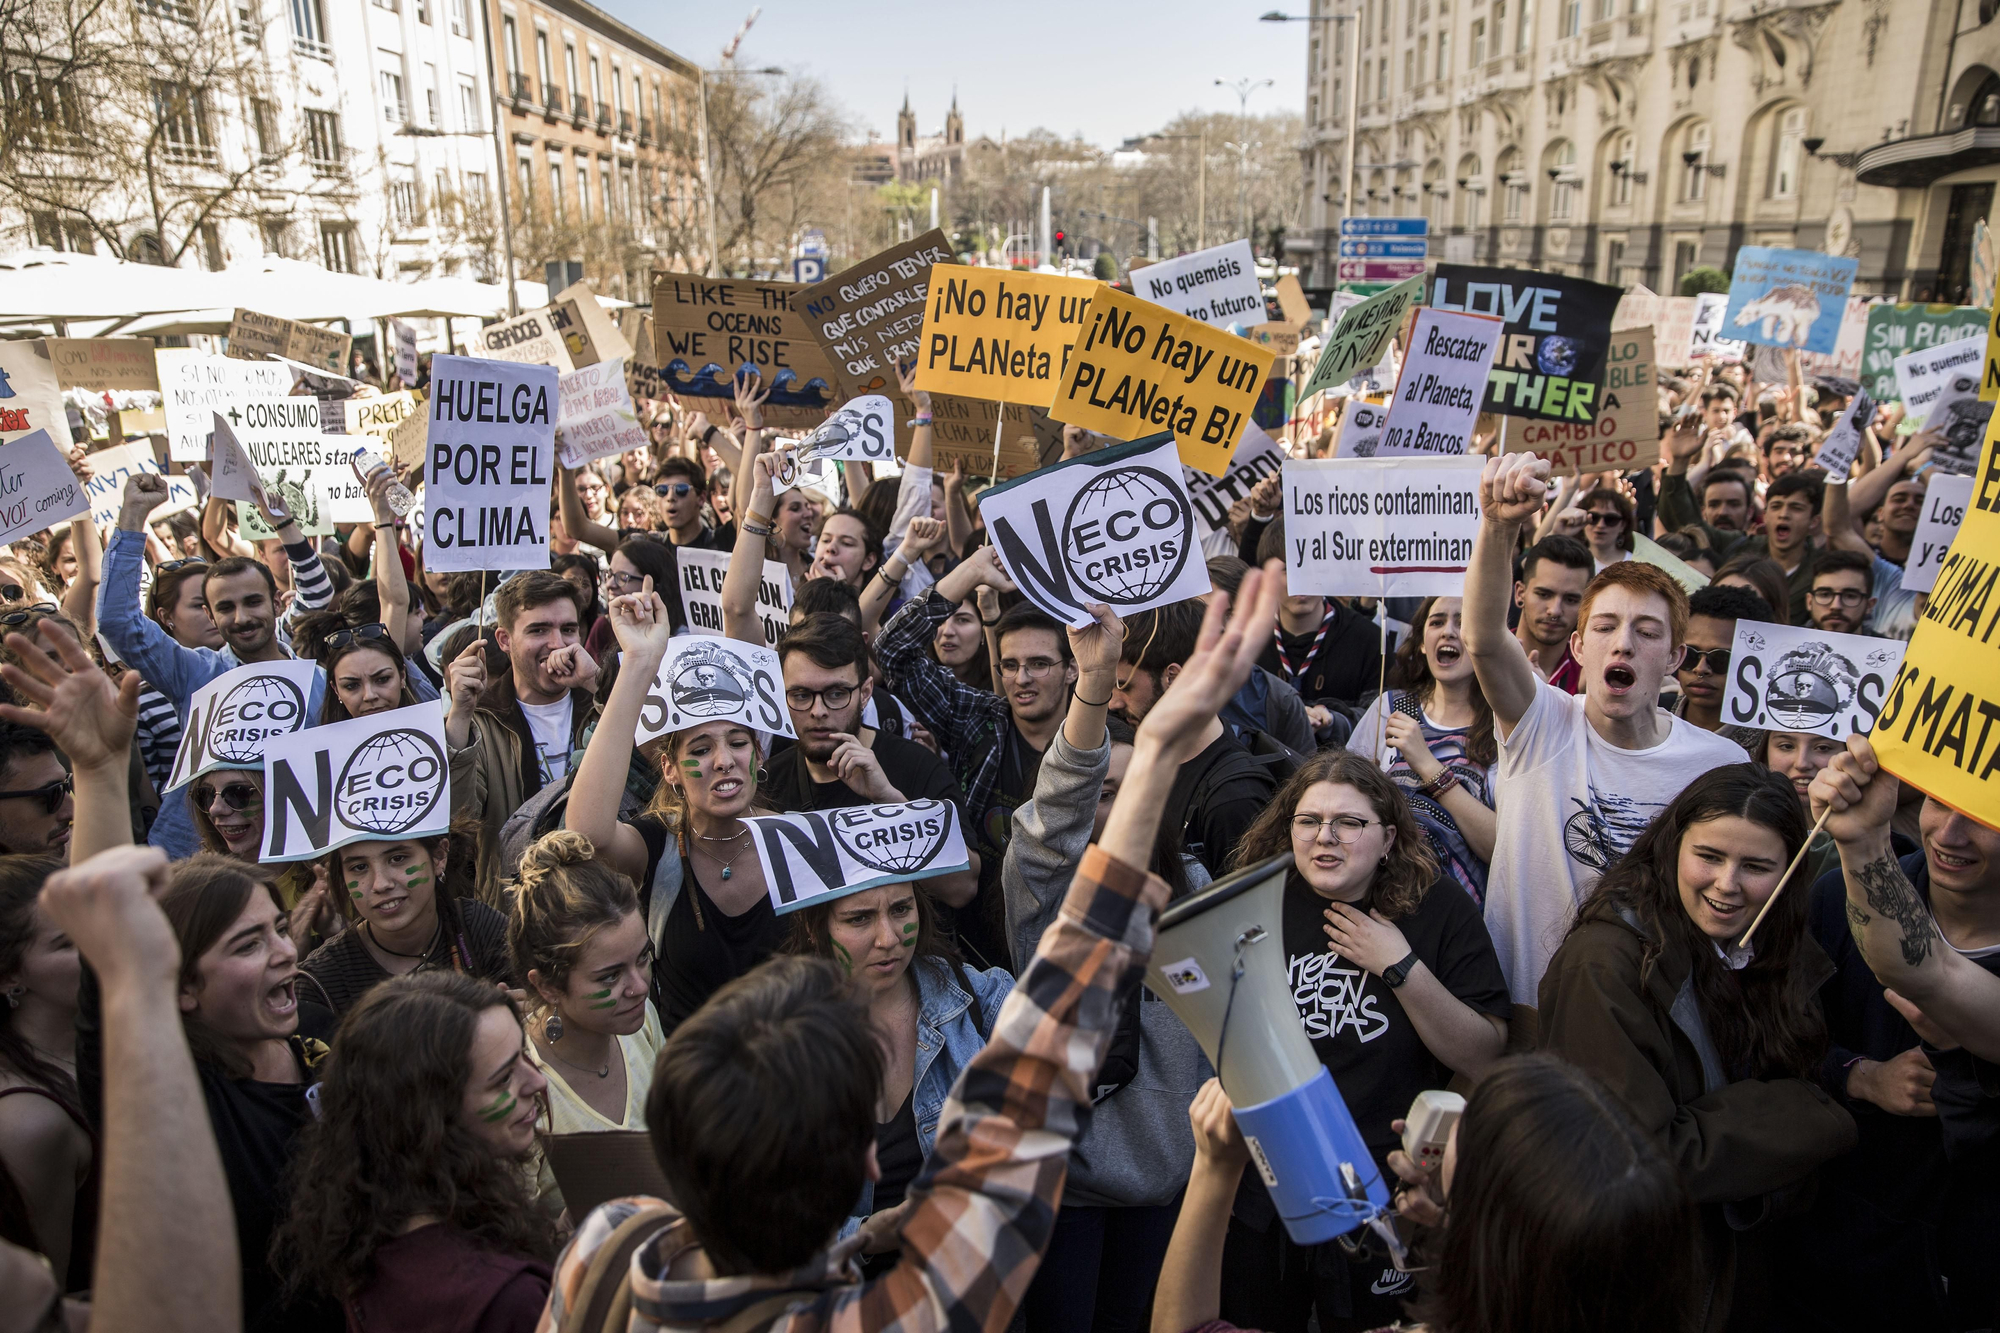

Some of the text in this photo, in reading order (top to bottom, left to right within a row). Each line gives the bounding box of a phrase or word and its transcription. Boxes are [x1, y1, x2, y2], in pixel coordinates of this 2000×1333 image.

[798, 260, 820, 283] P
[806, 296, 836, 319] NO
[889, 246, 950, 279] TENER
[1150, 258, 1241, 299] No queméis
[675, 281, 735, 306] LIKE
[934, 278, 986, 323] ¡No
[996, 282, 1050, 331] hay
[1211, 295, 1261, 319] futuro.
[1432, 277, 1562, 332] LOVE
[707, 311, 782, 335] OCEANS
[823, 313, 857, 340] QUE
[667, 331, 790, 367] WE RISE
[833, 336, 870, 360] MIS
[929, 333, 1051, 380] PLANeta
[1085, 306, 1146, 354] ¡No
[1151, 323, 1214, 384] hay
[1217, 355, 1259, 394] un
[1424, 325, 1487, 362] Rescatar
[846, 354, 880, 376] QUE
[1909, 348, 1981, 379] No queméis
[435, 379, 549, 424] HUELGA
[1069, 361, 1198, 436] PLANeta
[1405, 373, 1474, 416] al Planeta,
[246, 403, 318, 429] CONSUMO
[571, 414, 615, 440] MUERTO
[978, 401, 1024, 423] TIENE
[1201, 405, 1242, 450] B!
[932, 421, 995, 444] ECHA DE
[1384, 426, 1402, 448] no
[1403, 428, 1413, 449] a
[1523, 417, 1617, 444] CAMBIO
[248, 441, 321, 467] NUCLEARES
[432, 444, 500, 485] POR
[511, 445, 546, 485] EL
[932, 450, 1006, 472] ADUCIDAD
[35, 482, 79, 513] coming
[1294, 484, 1479, 520] Los ricos contaminan,
[1930, 497, 1964, 527] Los
[432, 506, 545, 549] CLIMA.
[1072, 498, 1180, 557] ECO
[1085, 540, 1178, 582] CRISIS
[1296, 531, 1473, 568] y al Sur exterminan
[1918, 542, 1934, 568] y
[683, 564, 710, 593] ¡EL
[216, 700, 298, 728] ECO
[347, 756, 438, 798] ECO
[347, 790, 430, 817] CRISIS
[838, 800, 940, 828] ECO
[854, 817, 941, 851] CRISIS
